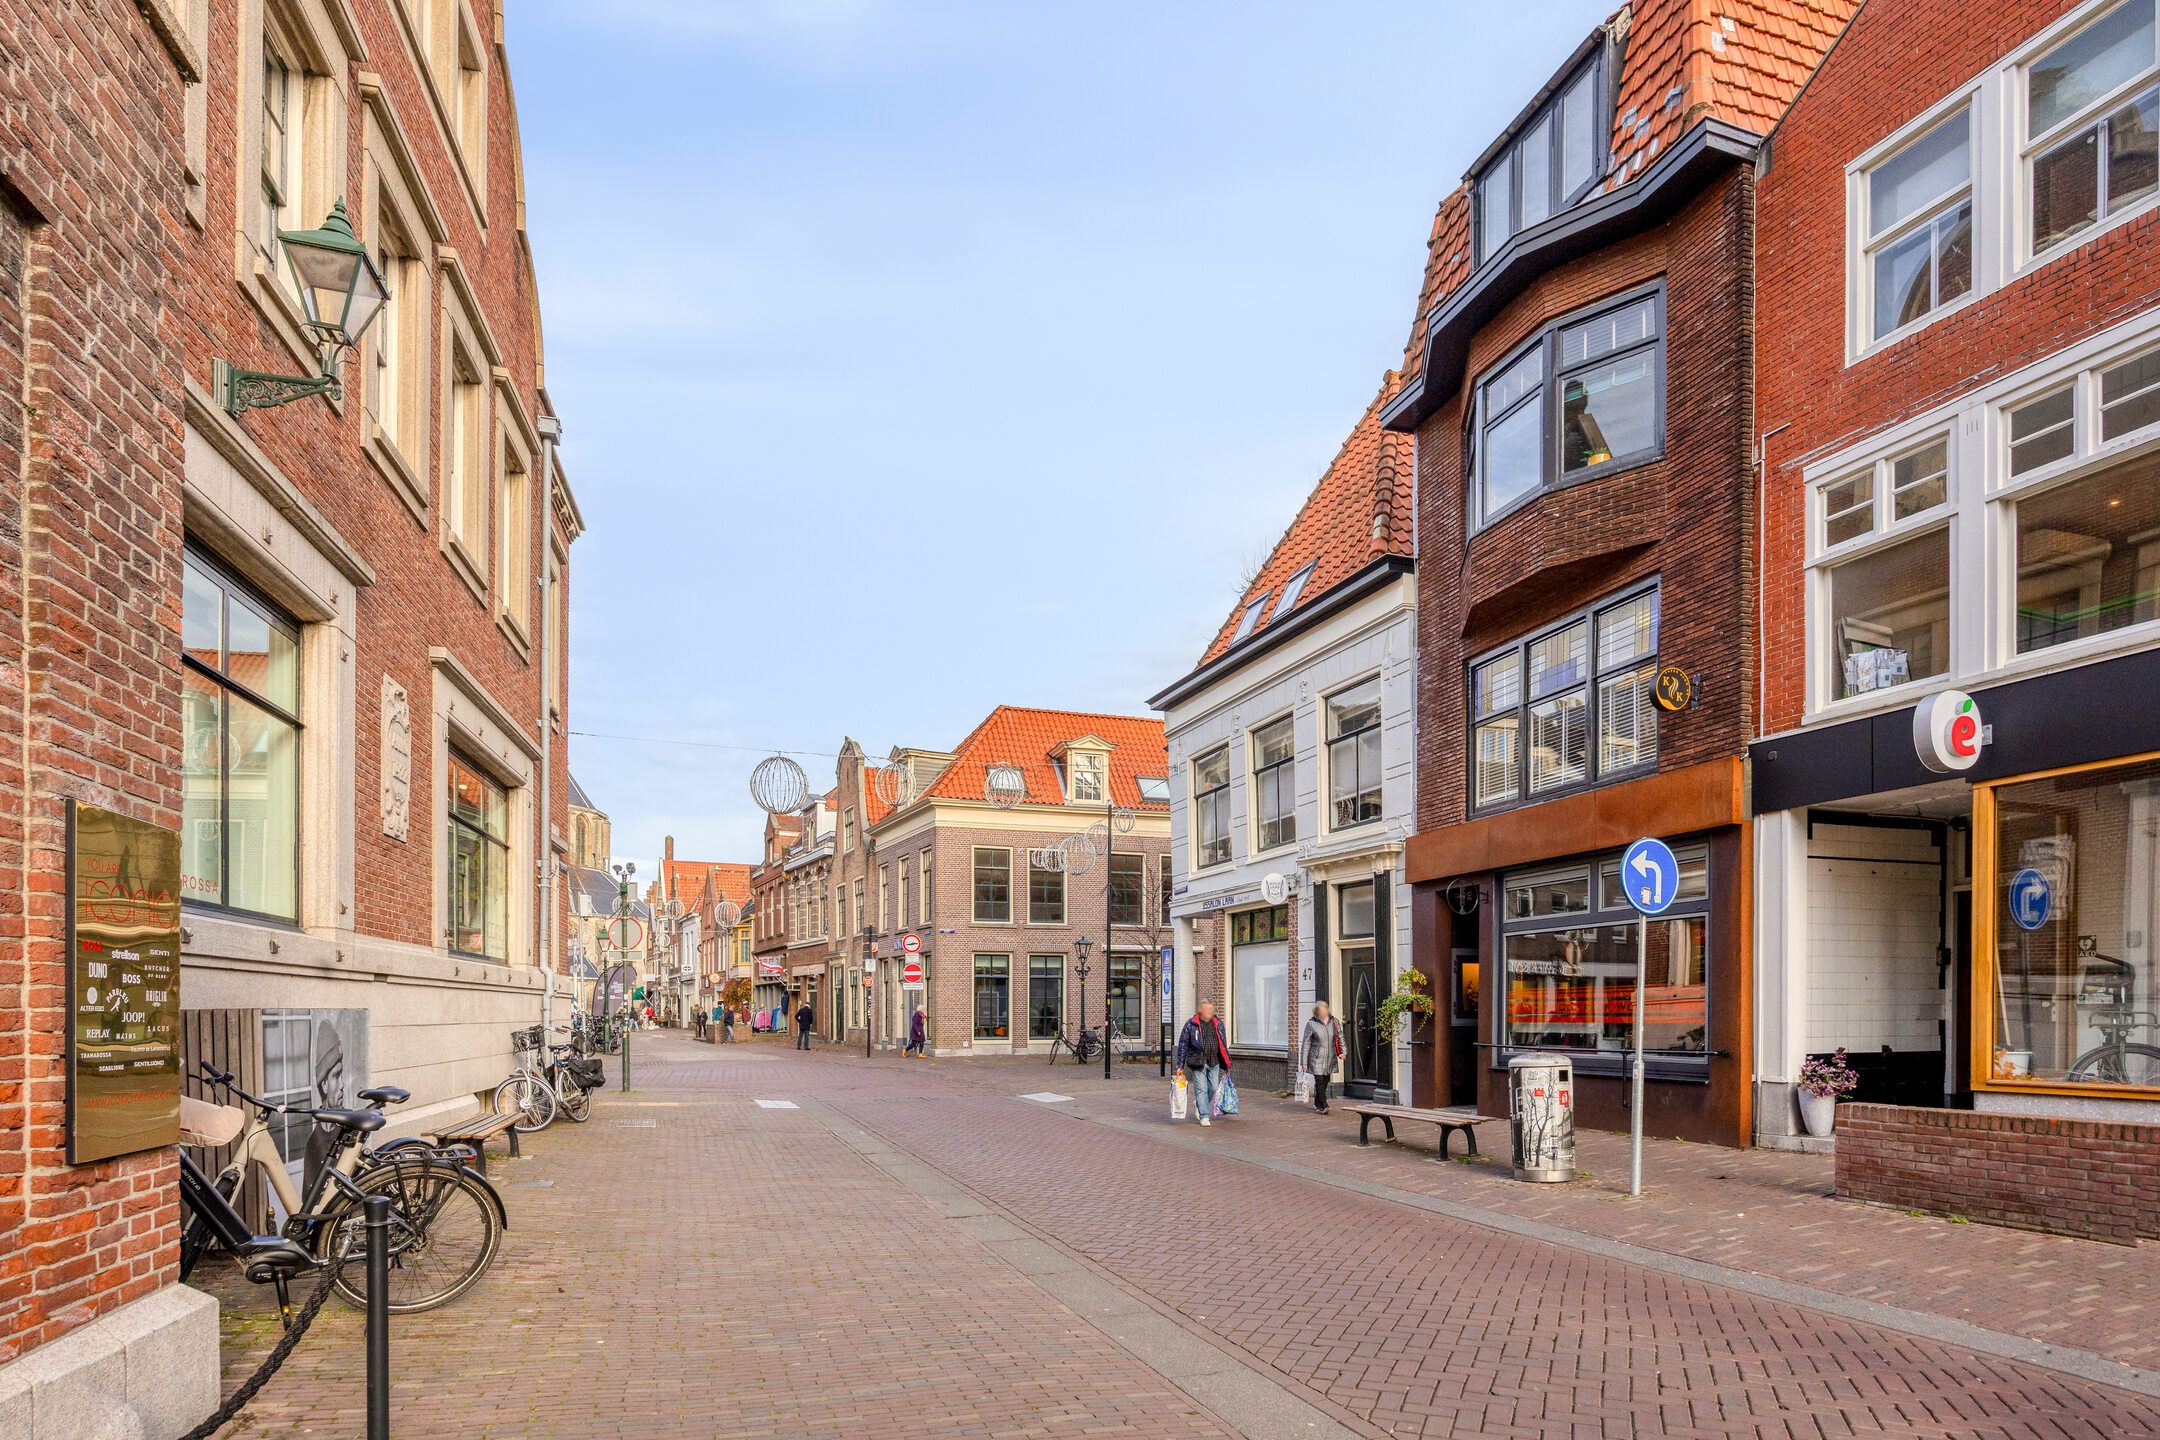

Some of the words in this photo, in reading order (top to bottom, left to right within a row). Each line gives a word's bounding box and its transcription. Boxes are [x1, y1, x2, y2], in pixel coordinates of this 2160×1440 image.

[1663, 677, 1670, 686] K
[1676, 692, 1683, 702] K
[86, 857, 104, 872] YOU
[182, 874, 219, 894] ROSSA
[84, 876, 174, 930] ICONIC
[111, 949, 140, 961] strellson
[149, 949, 170, 957] GENTI
[88, 961, 107, 979] DUNO
[144, 964, 170, 972] BUTCHER
[122, 973, 141, 984] BOSS
[1303, 968, 1313, 980] 47
[105, 987, 130, 1004] PARBLEU
[121, 1012, 146, 1023] JOOP!
[86, 1028, 110, 1039] REPLAY
[81, 1051, 112, 1059] TRAMAROSSA
[98, 1064, 125, 1072] SCAGLIONE
